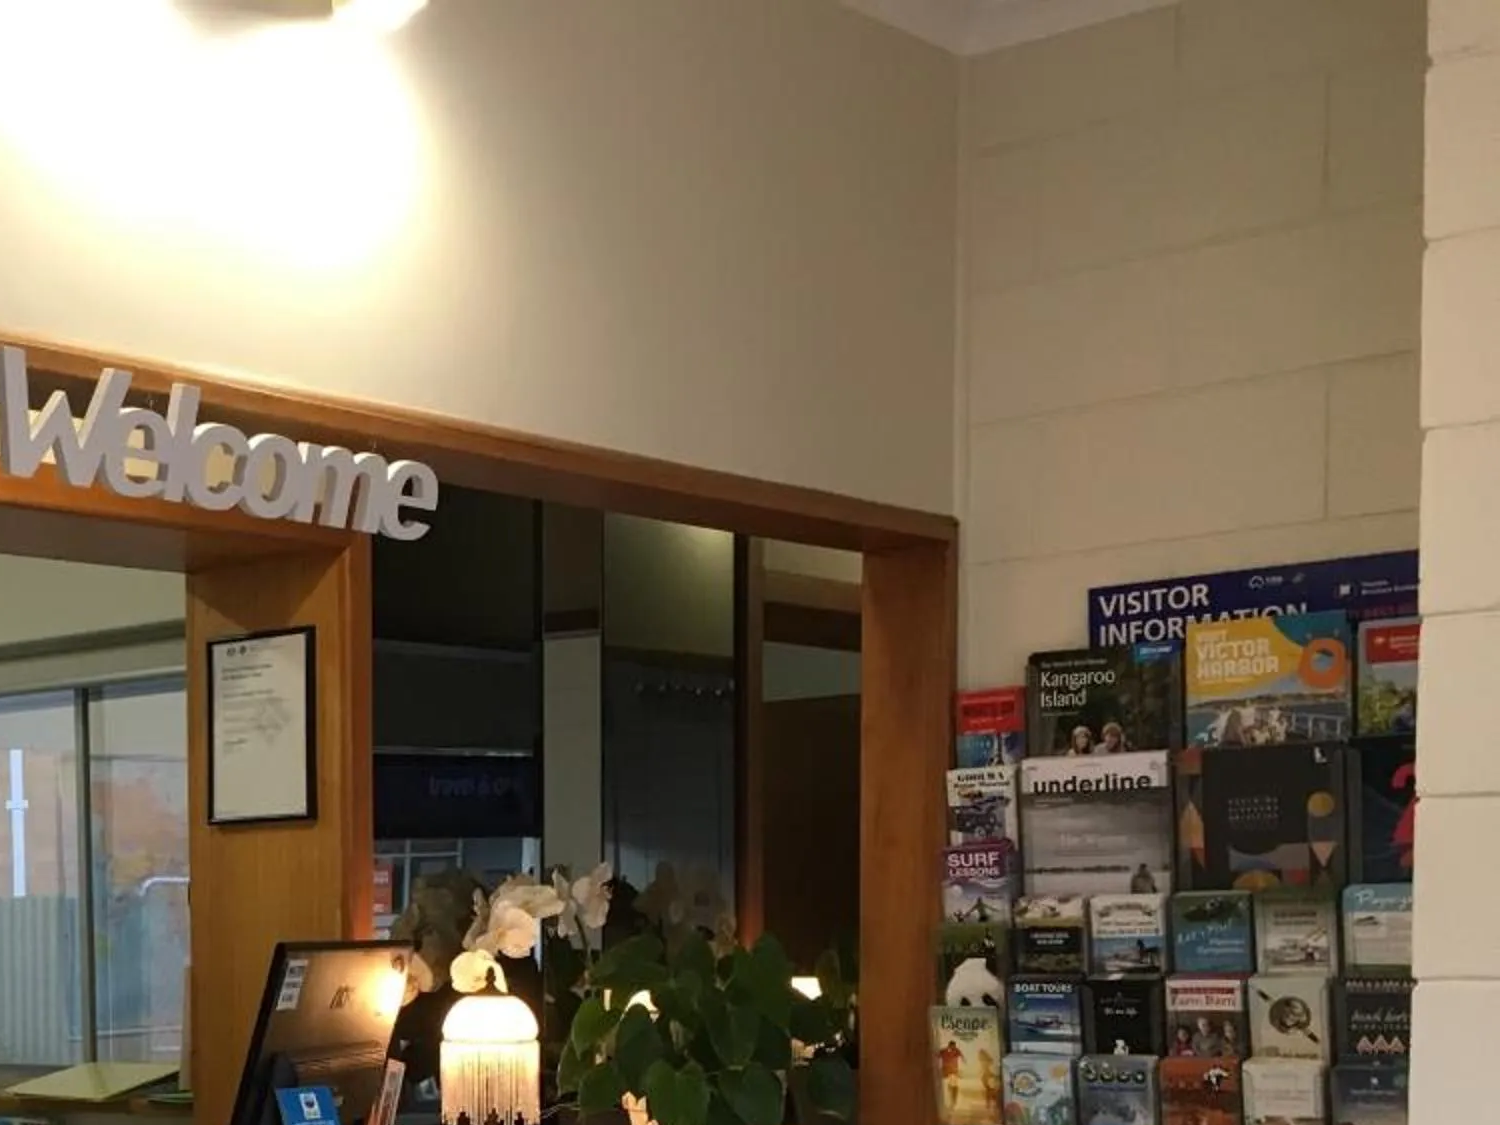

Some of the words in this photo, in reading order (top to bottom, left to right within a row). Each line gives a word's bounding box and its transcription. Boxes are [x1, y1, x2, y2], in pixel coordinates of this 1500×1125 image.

[1099, 583, 1209, 617] VISITOR
[1100, 602, 1307, 646] INFORON
[1197, 638, 1270, 660] VICTOR
[1197, 656, 1280, 680] HARBOR
[1040, 670, 1116, 690] Kangaroo
[1040, 689, 1088, 708] Island
[1033, 773, 1152, 795] underline
[948, 851, 1000, 868] SURF
[949, 866, 1000, 877] LESSONS
[1014, 983, 1040, 993] BOAT
[1041, 983, 1073, 993] TOURS
